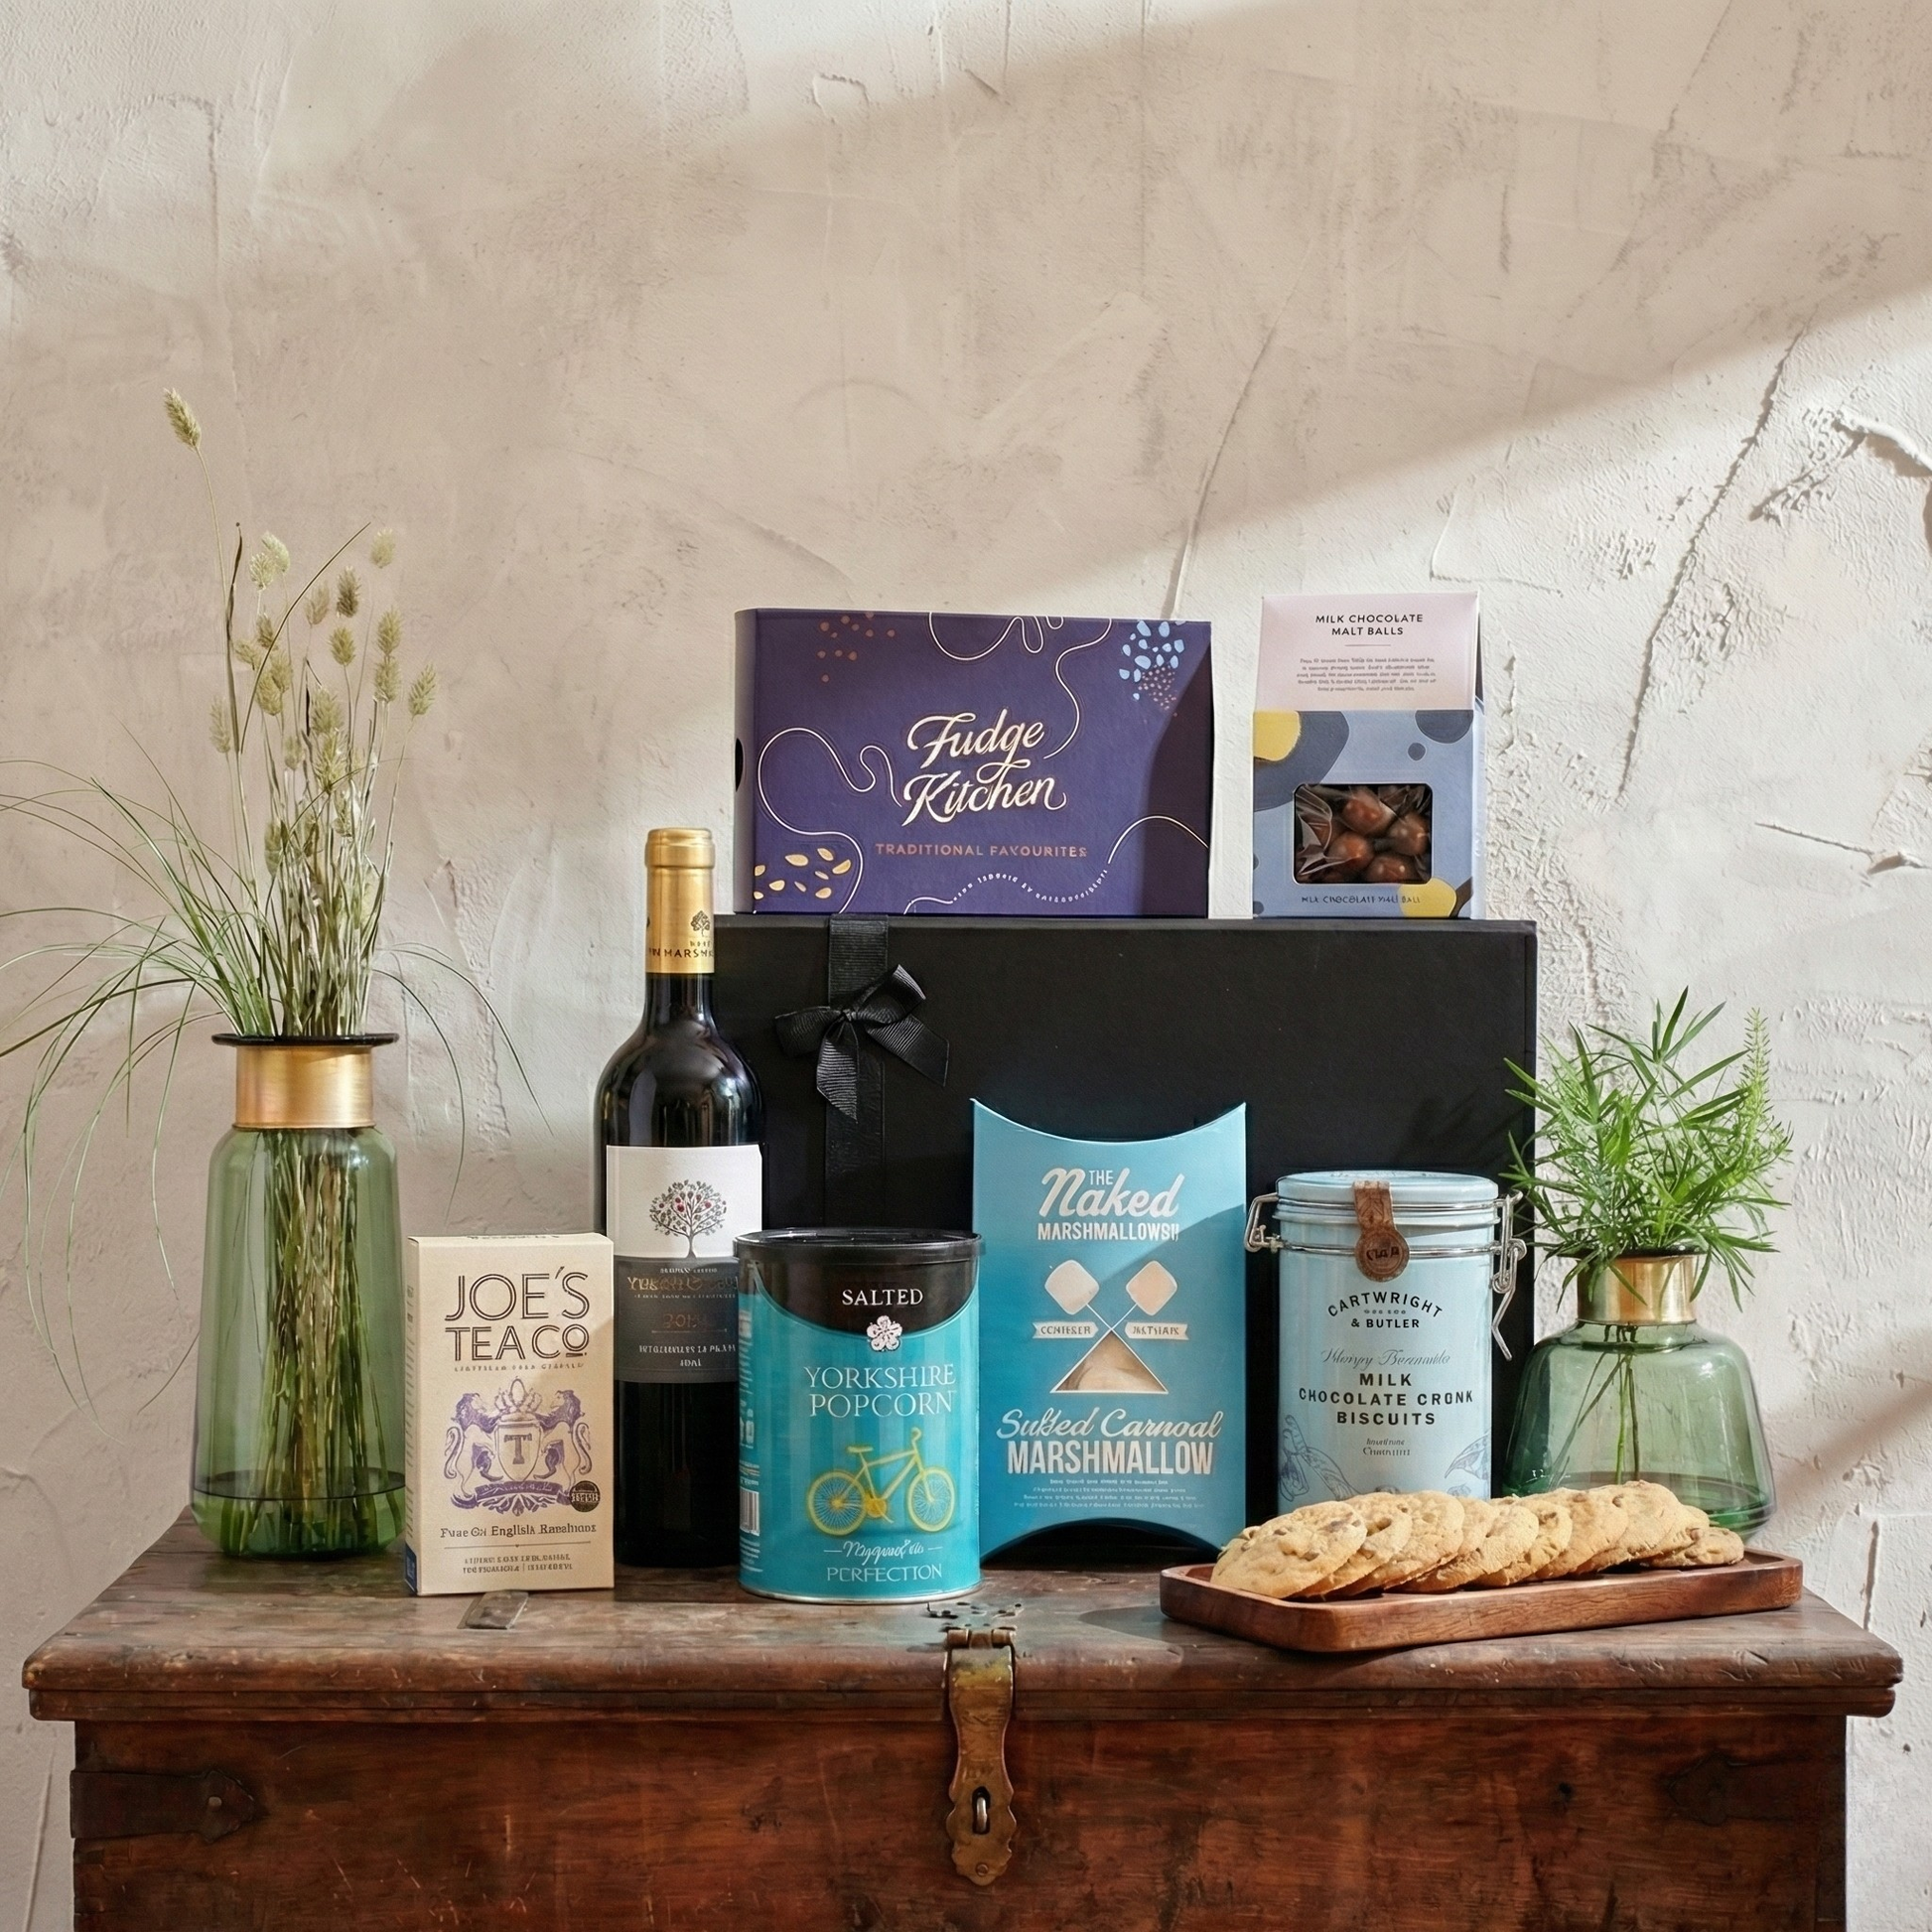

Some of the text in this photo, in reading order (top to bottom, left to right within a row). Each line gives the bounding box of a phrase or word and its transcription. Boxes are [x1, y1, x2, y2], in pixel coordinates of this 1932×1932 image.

[1315, 614, 1424, 623] MILK CHOCOLATE
[1331, 626, 1404, 635] MALT BALLS
[907, 707, 1044, 772] Fudge
[901, 761, 1067, 826] Kitchen
[876, 844, 1087, 858] TRADITIONAL FAVOURITES
[1088, 1170, 1114, 1185] THE
[1038, 1168, 1185, 1218] Naked
[445, 1266, 590, 1321] JOE'S
[842, 1289, 923, 1306] SALTED
[1327, 1291, 1443, 1317] CARTWRIGHT
[1351, 1318, 1421, 1328] & BUTLER
[804, 1364, 956, 1389] YORKSHIRE
[1359, 1373, 1412, 1387] MILK
[809, 1392, 955, 1418] POPCORN
[1299, 1387, 1407, 1406] CHOCOLATE
[1336, 1412, 1436, 1426] BISCUITS
[1008, 1441, 1213, 1475] MARSHMALLOW
